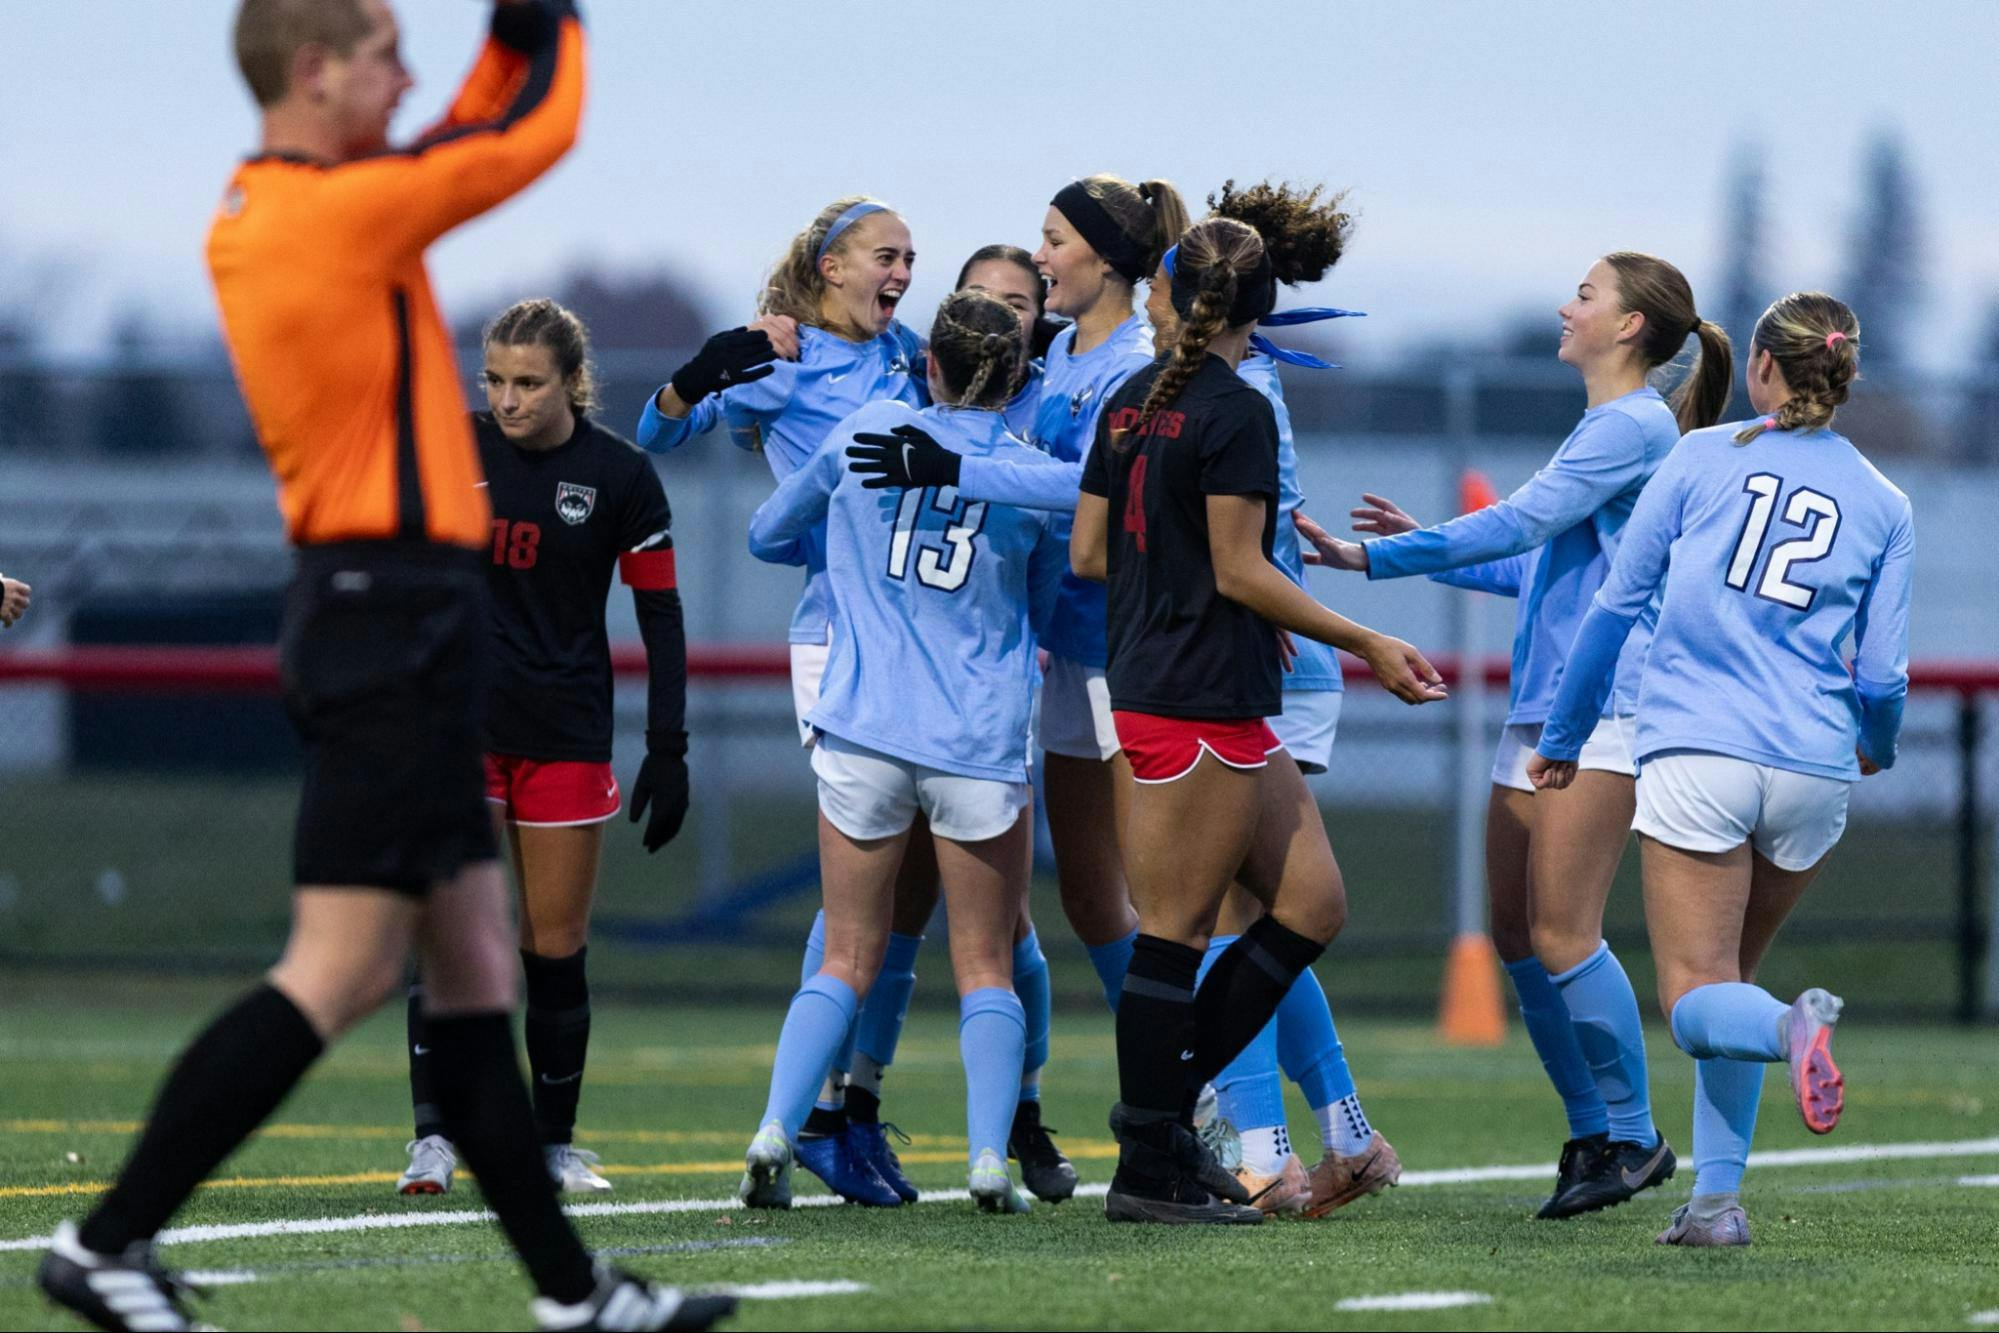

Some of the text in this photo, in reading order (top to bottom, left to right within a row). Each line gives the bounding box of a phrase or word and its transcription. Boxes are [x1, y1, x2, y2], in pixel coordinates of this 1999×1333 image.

[490, 517, 542, 570] 18
[886, 482, 990, 594] 13
[1122, 453, 1148, 553] 4
[1724, 471, 1842, 613] 12
